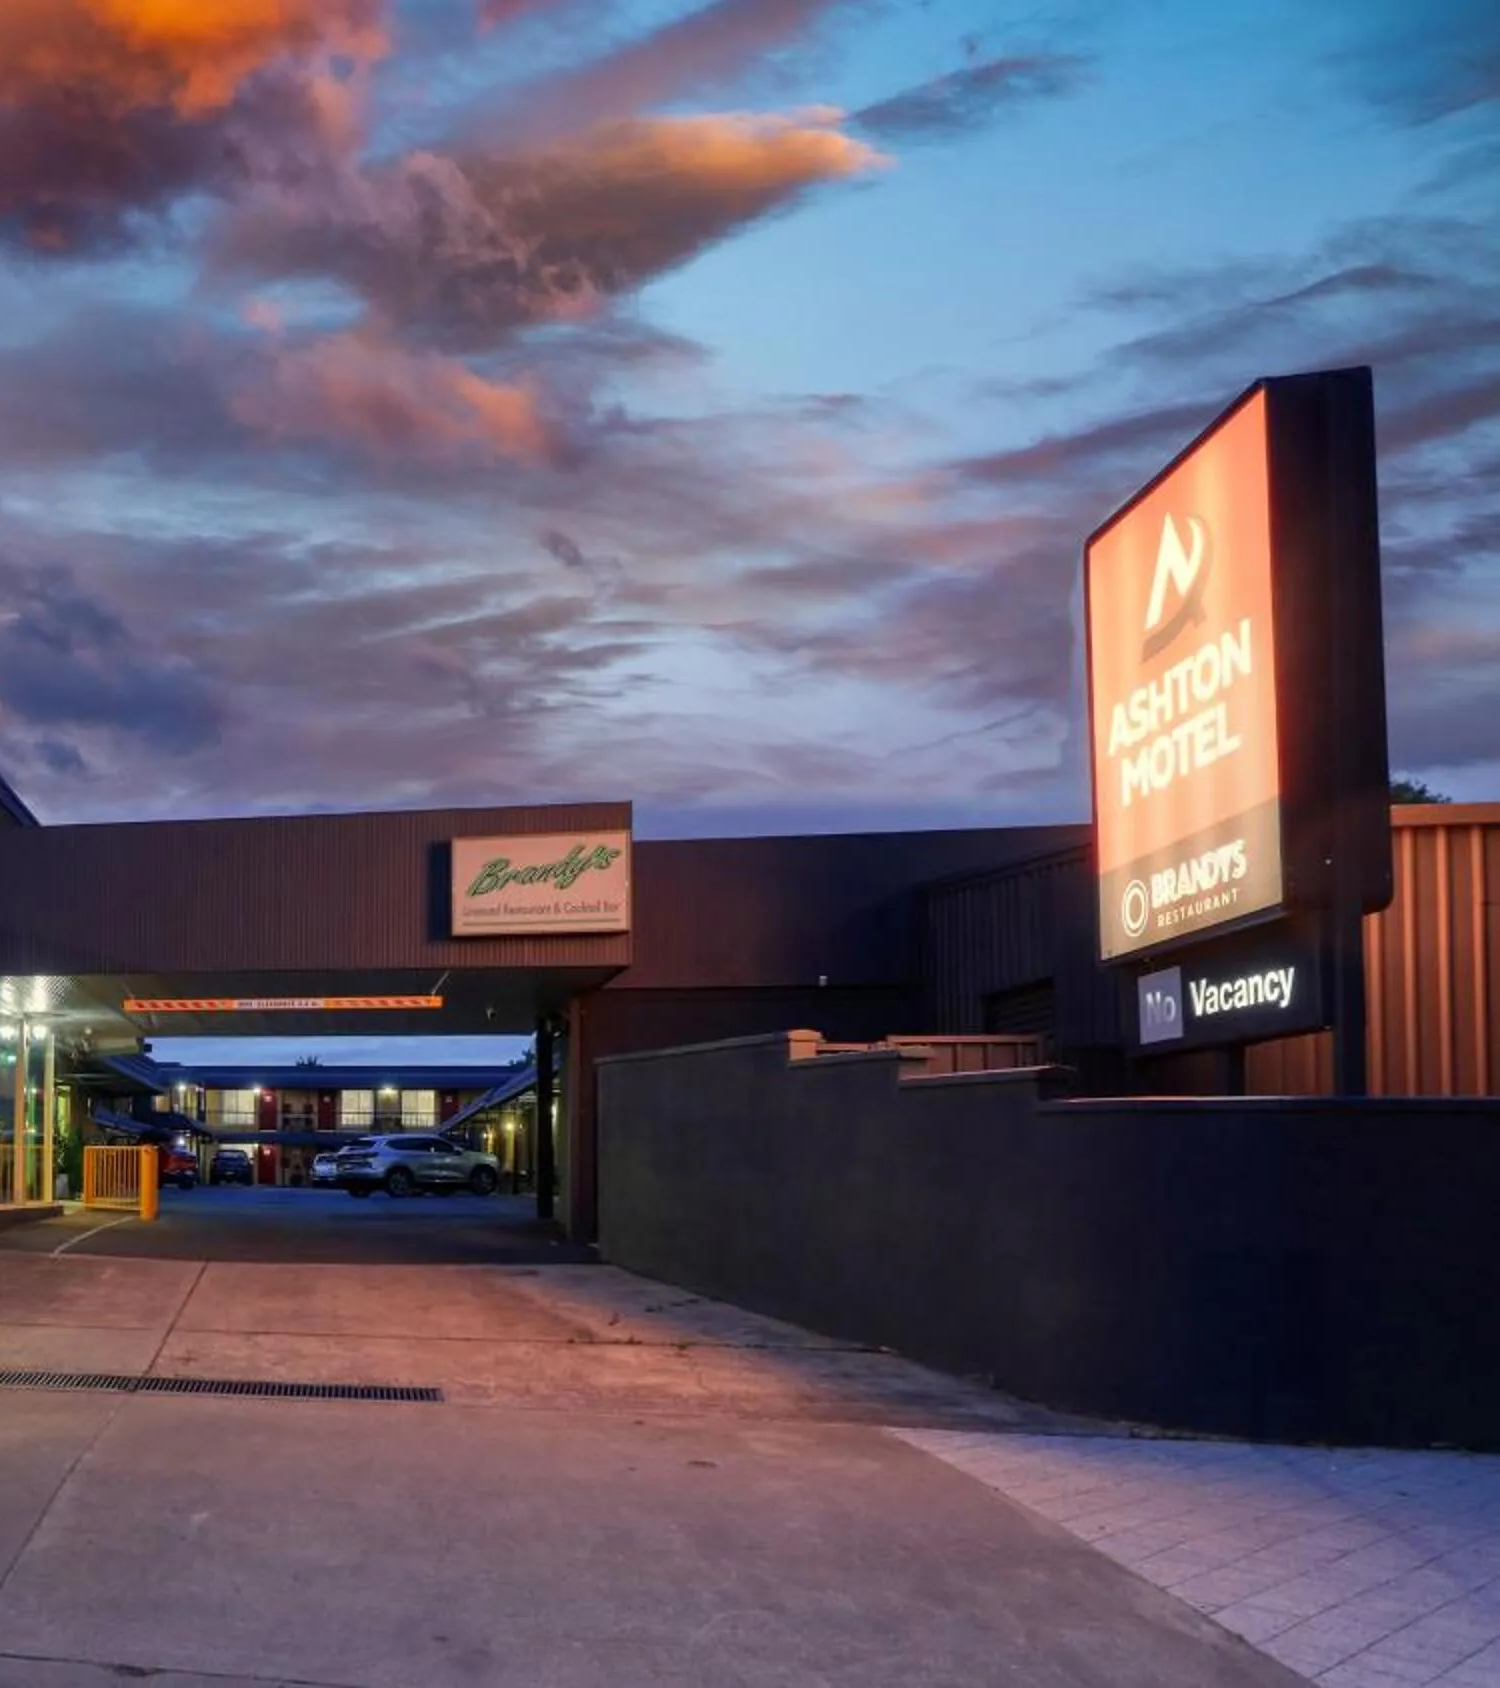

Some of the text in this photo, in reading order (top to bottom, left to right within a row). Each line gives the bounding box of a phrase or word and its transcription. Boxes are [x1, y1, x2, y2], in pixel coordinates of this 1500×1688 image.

[1107, 618, 1252, 756] ASHTON
[1120, 702, 1243, 807] MOTEL
[1156, 887, 1239, 927] RESTAURANT
[1145, 966, 1296, 1028] No Vacancy
